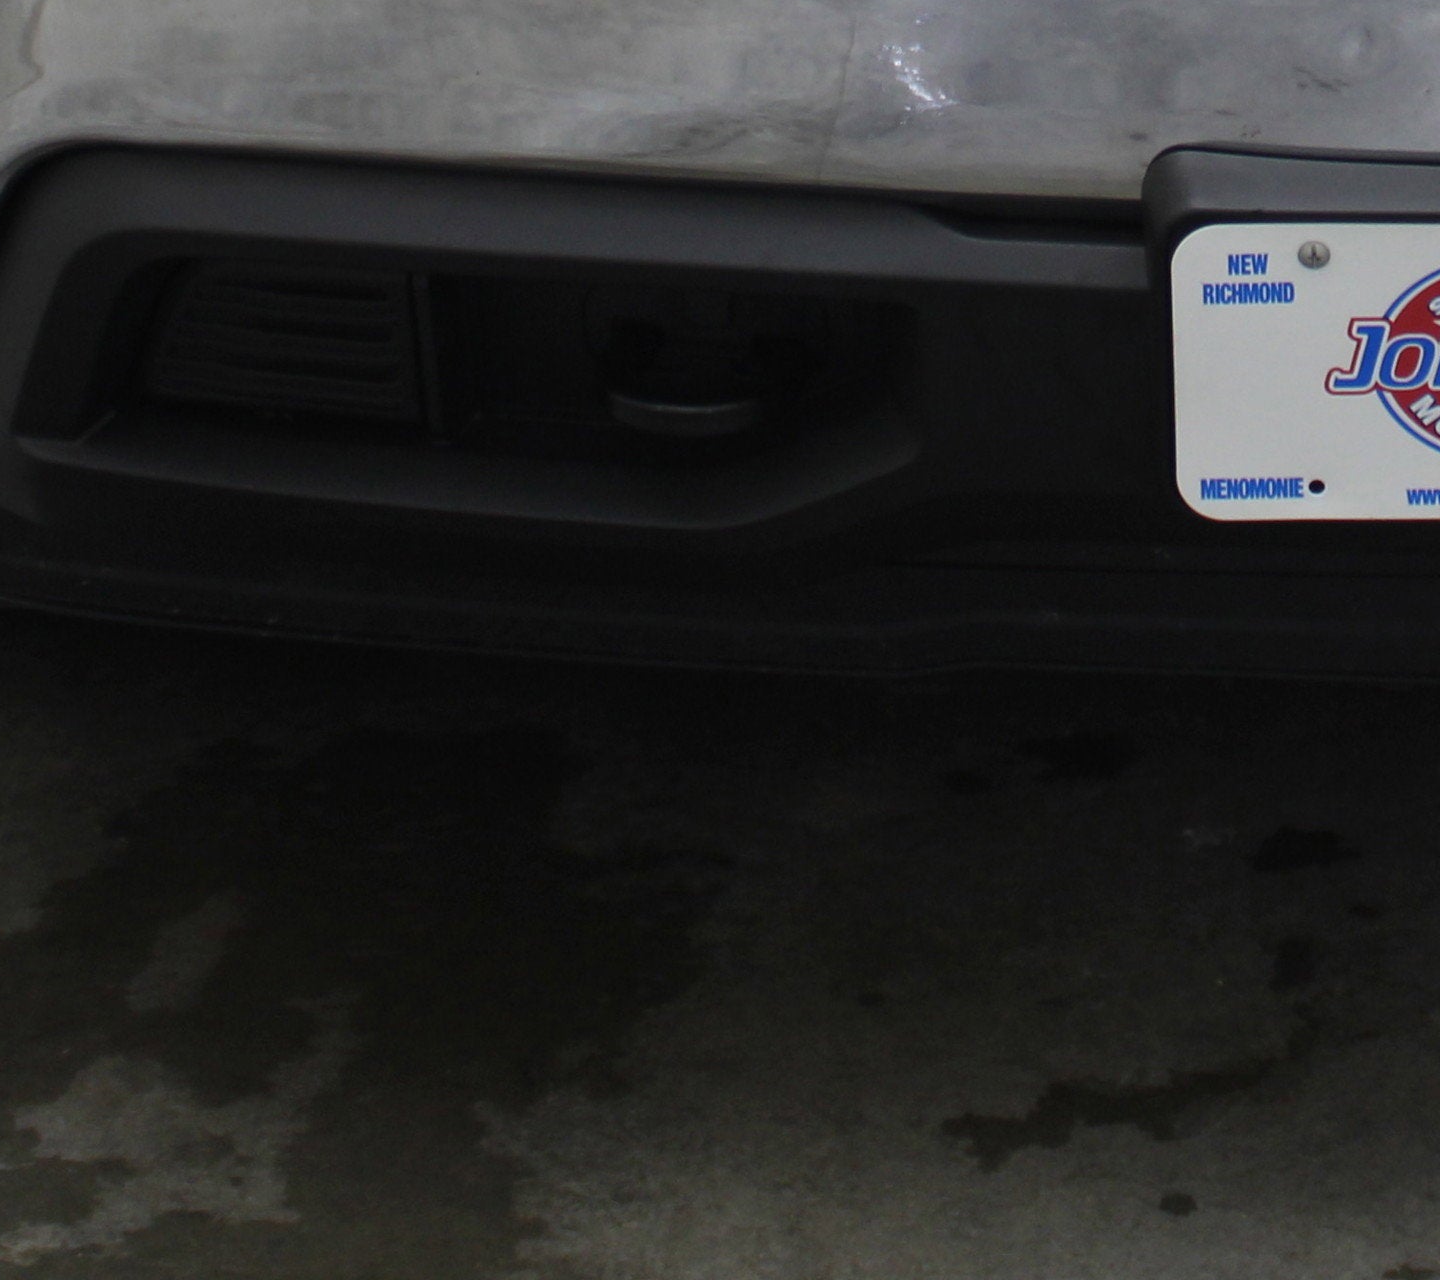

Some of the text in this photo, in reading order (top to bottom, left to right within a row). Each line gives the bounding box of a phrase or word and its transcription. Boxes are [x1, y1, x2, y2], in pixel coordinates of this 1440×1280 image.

[1228, 254, 1268, 276] NEW
[1202, 282, 1295, 305] RICHMOND
[1200, 477, 1304, 500] MENOMONIE
